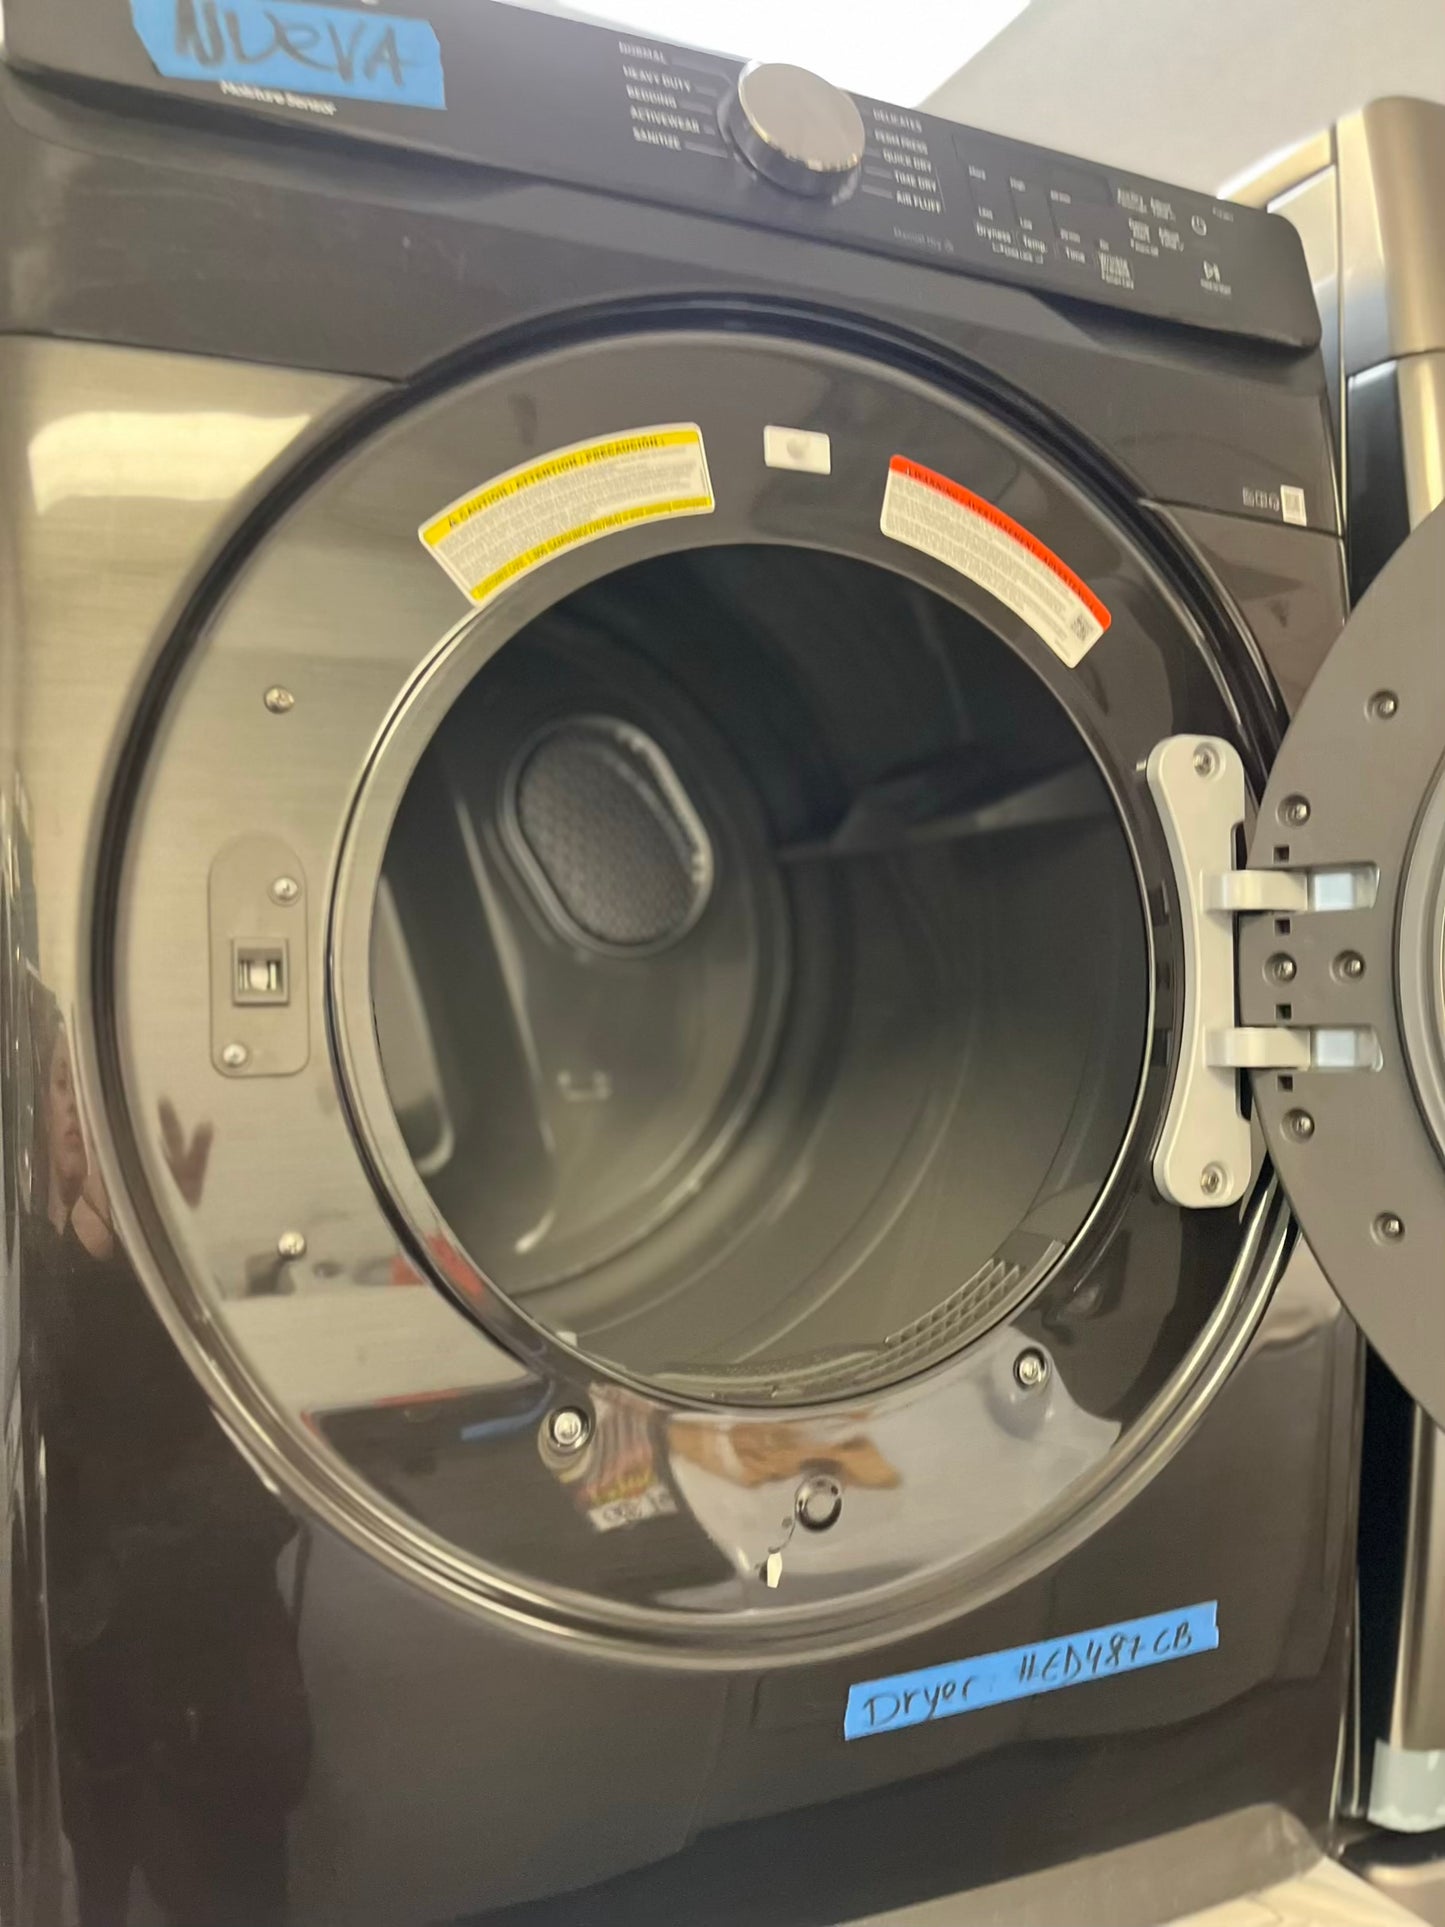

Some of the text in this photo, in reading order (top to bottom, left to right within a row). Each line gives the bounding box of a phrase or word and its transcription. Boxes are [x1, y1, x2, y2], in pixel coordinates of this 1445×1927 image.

[622, 64, 691, 92] HEAVY DUTY
[629, 104, 700, 134] ACTIVEWEAR
[872, 108, 923, 133] DELICATES
[882, 148, 932, 173] QUICK DRY
[917, 176, 937, 193] DRY
[896, 190, 942, 214] AIR FLUFF
[976, 221, 1012, 244] Dryness
